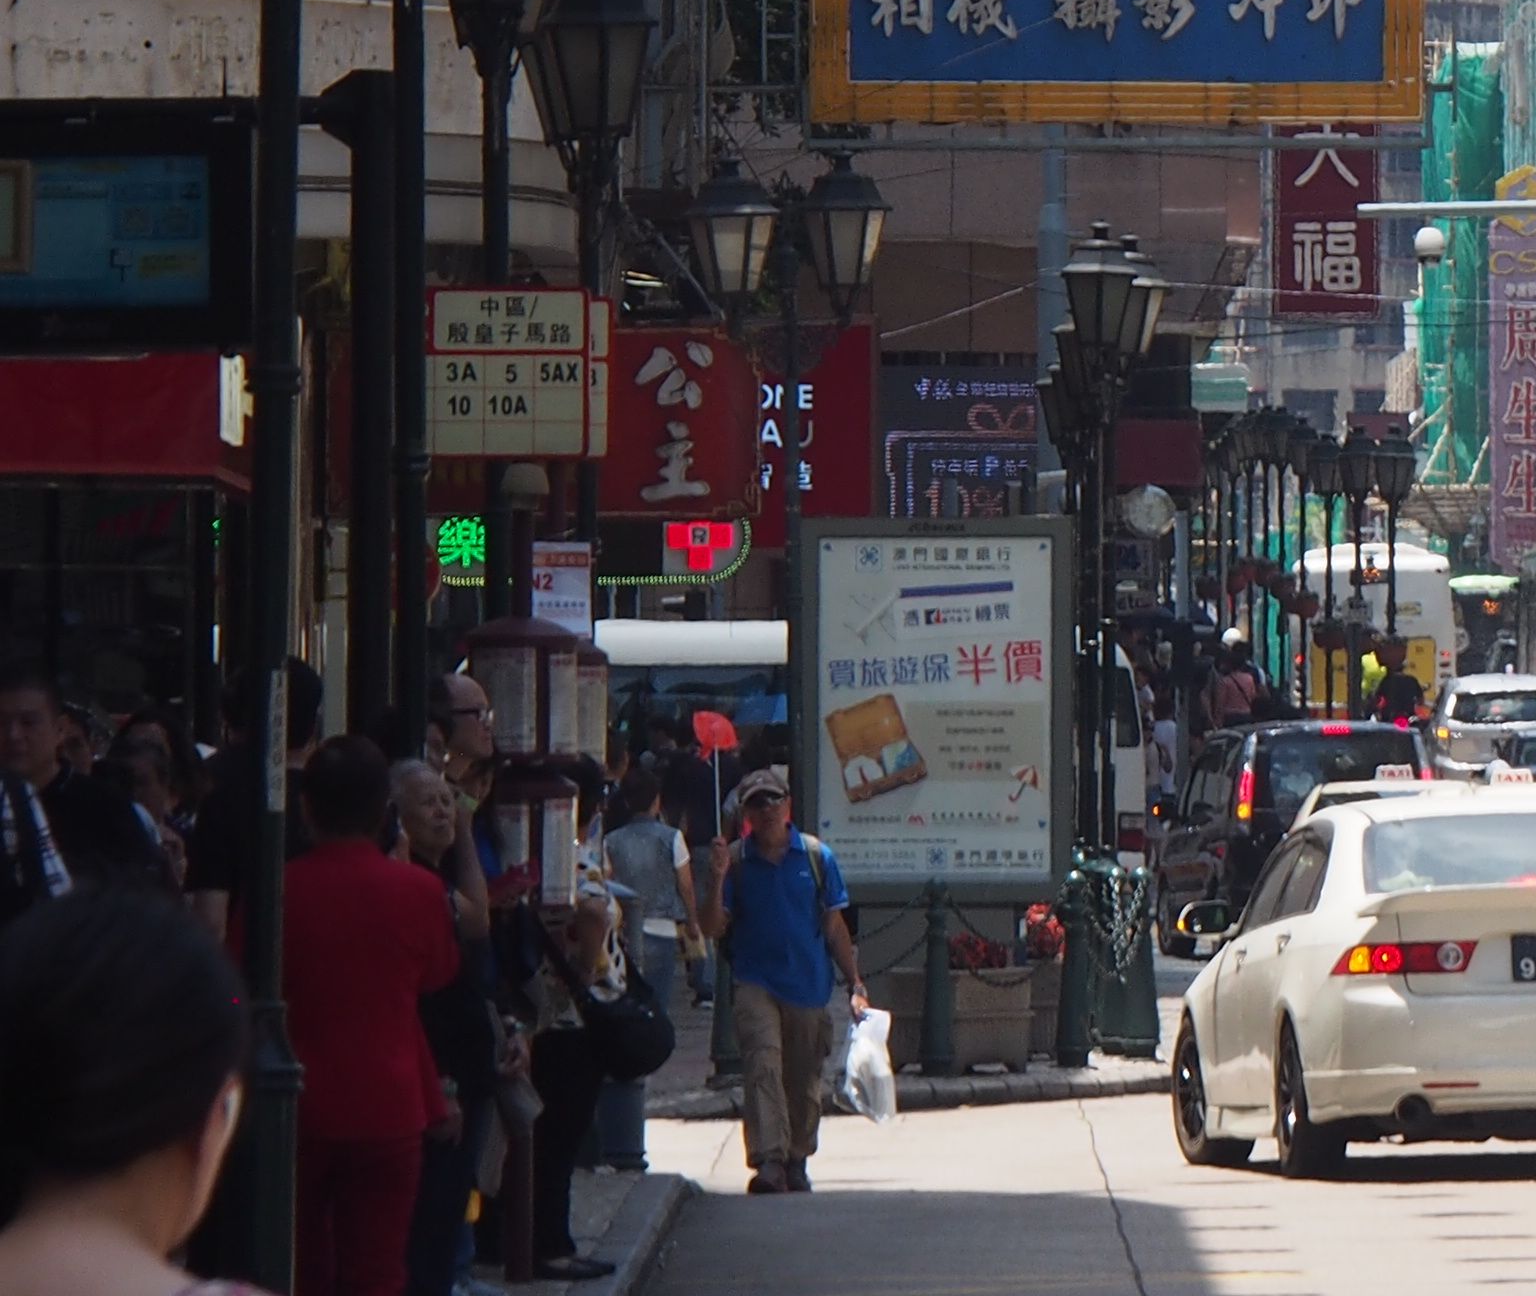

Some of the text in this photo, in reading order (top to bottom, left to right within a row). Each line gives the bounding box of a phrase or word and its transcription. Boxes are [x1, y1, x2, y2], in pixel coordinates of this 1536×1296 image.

[447, 322, 571, 345] 殷皇子馬路
[446, 362, 579, 384] 3A 5 5AX
[448, 395, 528, 416] 10 10A
[633, 340, 714, 503] 公主
